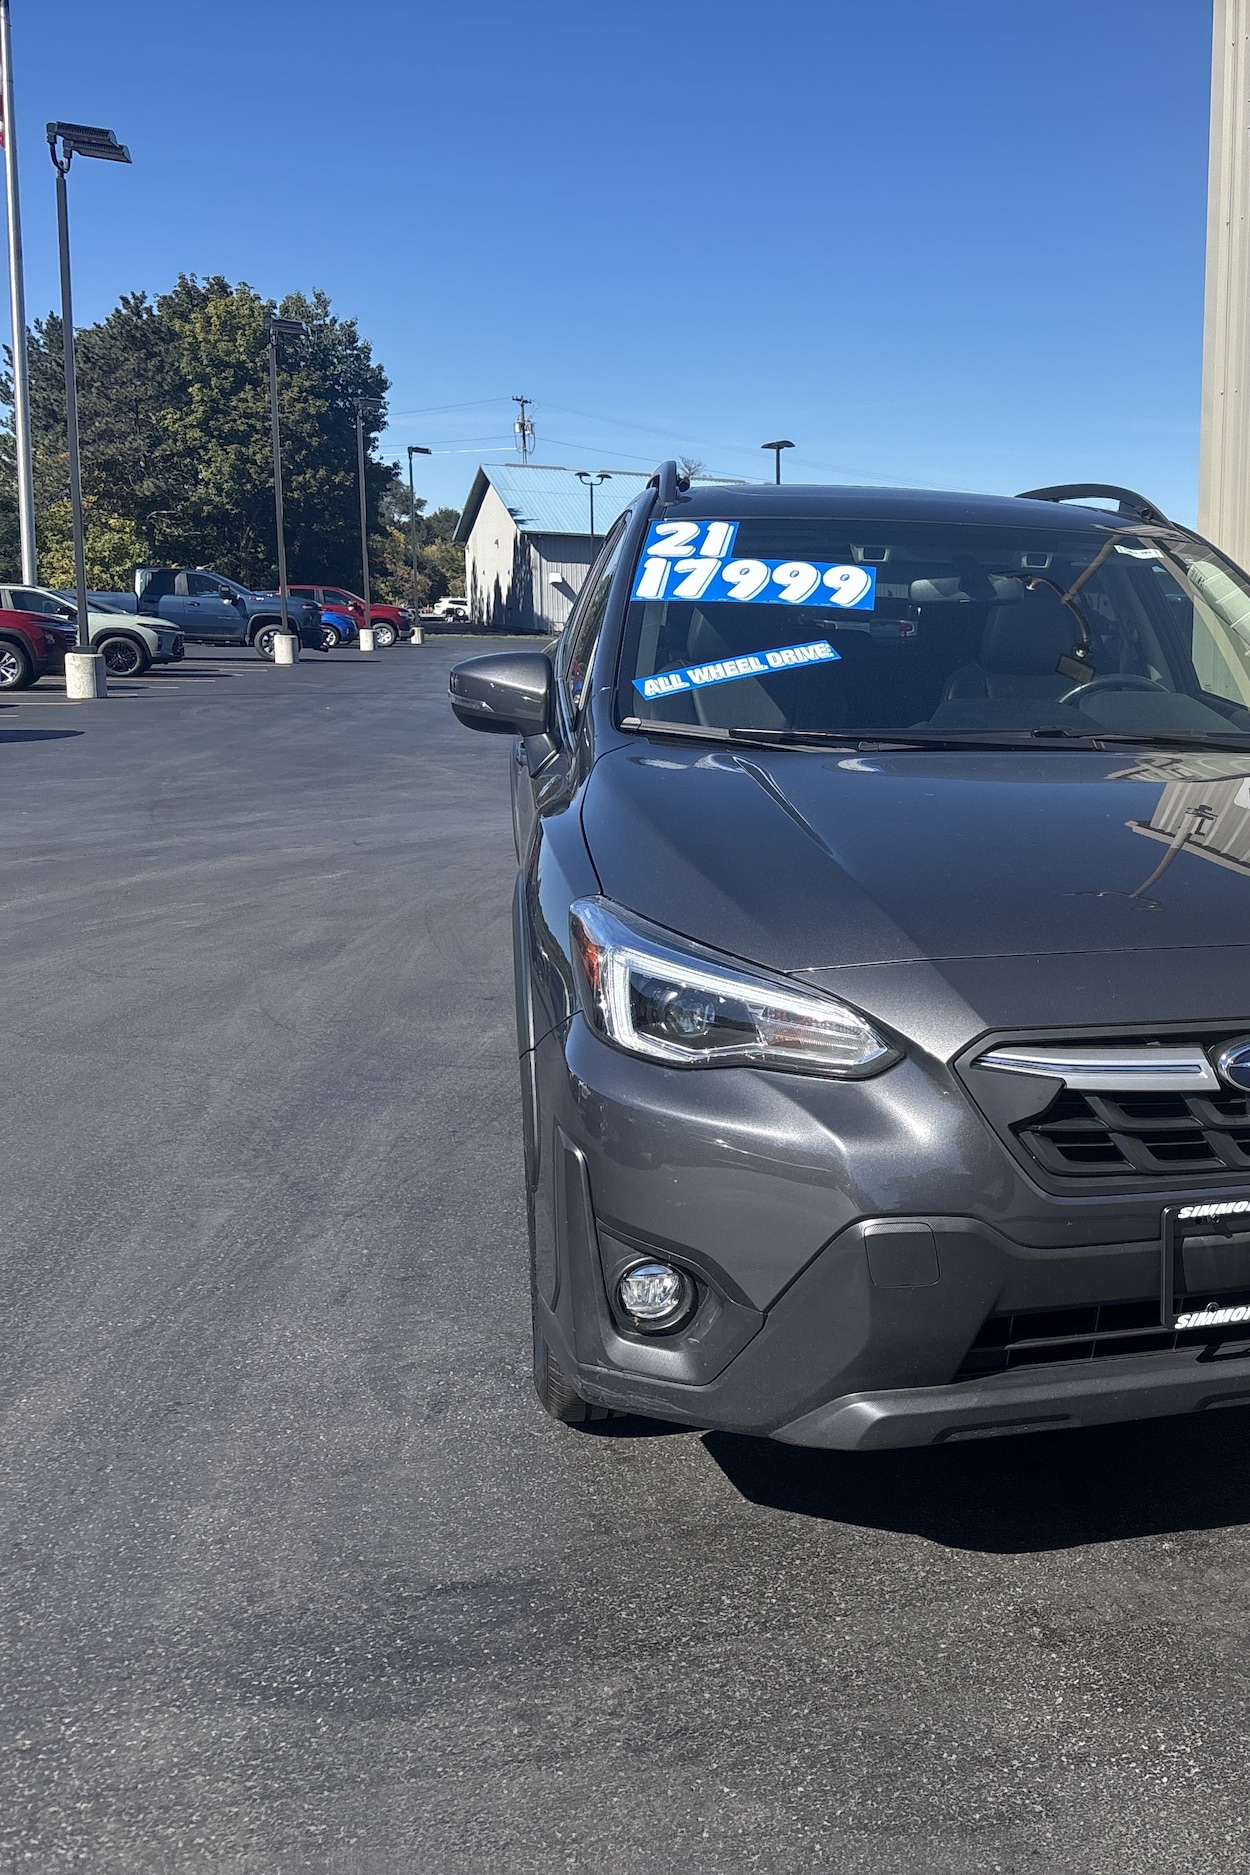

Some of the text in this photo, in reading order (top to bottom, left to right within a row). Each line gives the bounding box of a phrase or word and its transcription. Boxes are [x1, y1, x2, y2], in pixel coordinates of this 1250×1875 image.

[647, 521, 734, 558] 21
[636, 558, 872, 608] 17999
[644, 643, 835, 697] ALL WHEEL DRIVE
